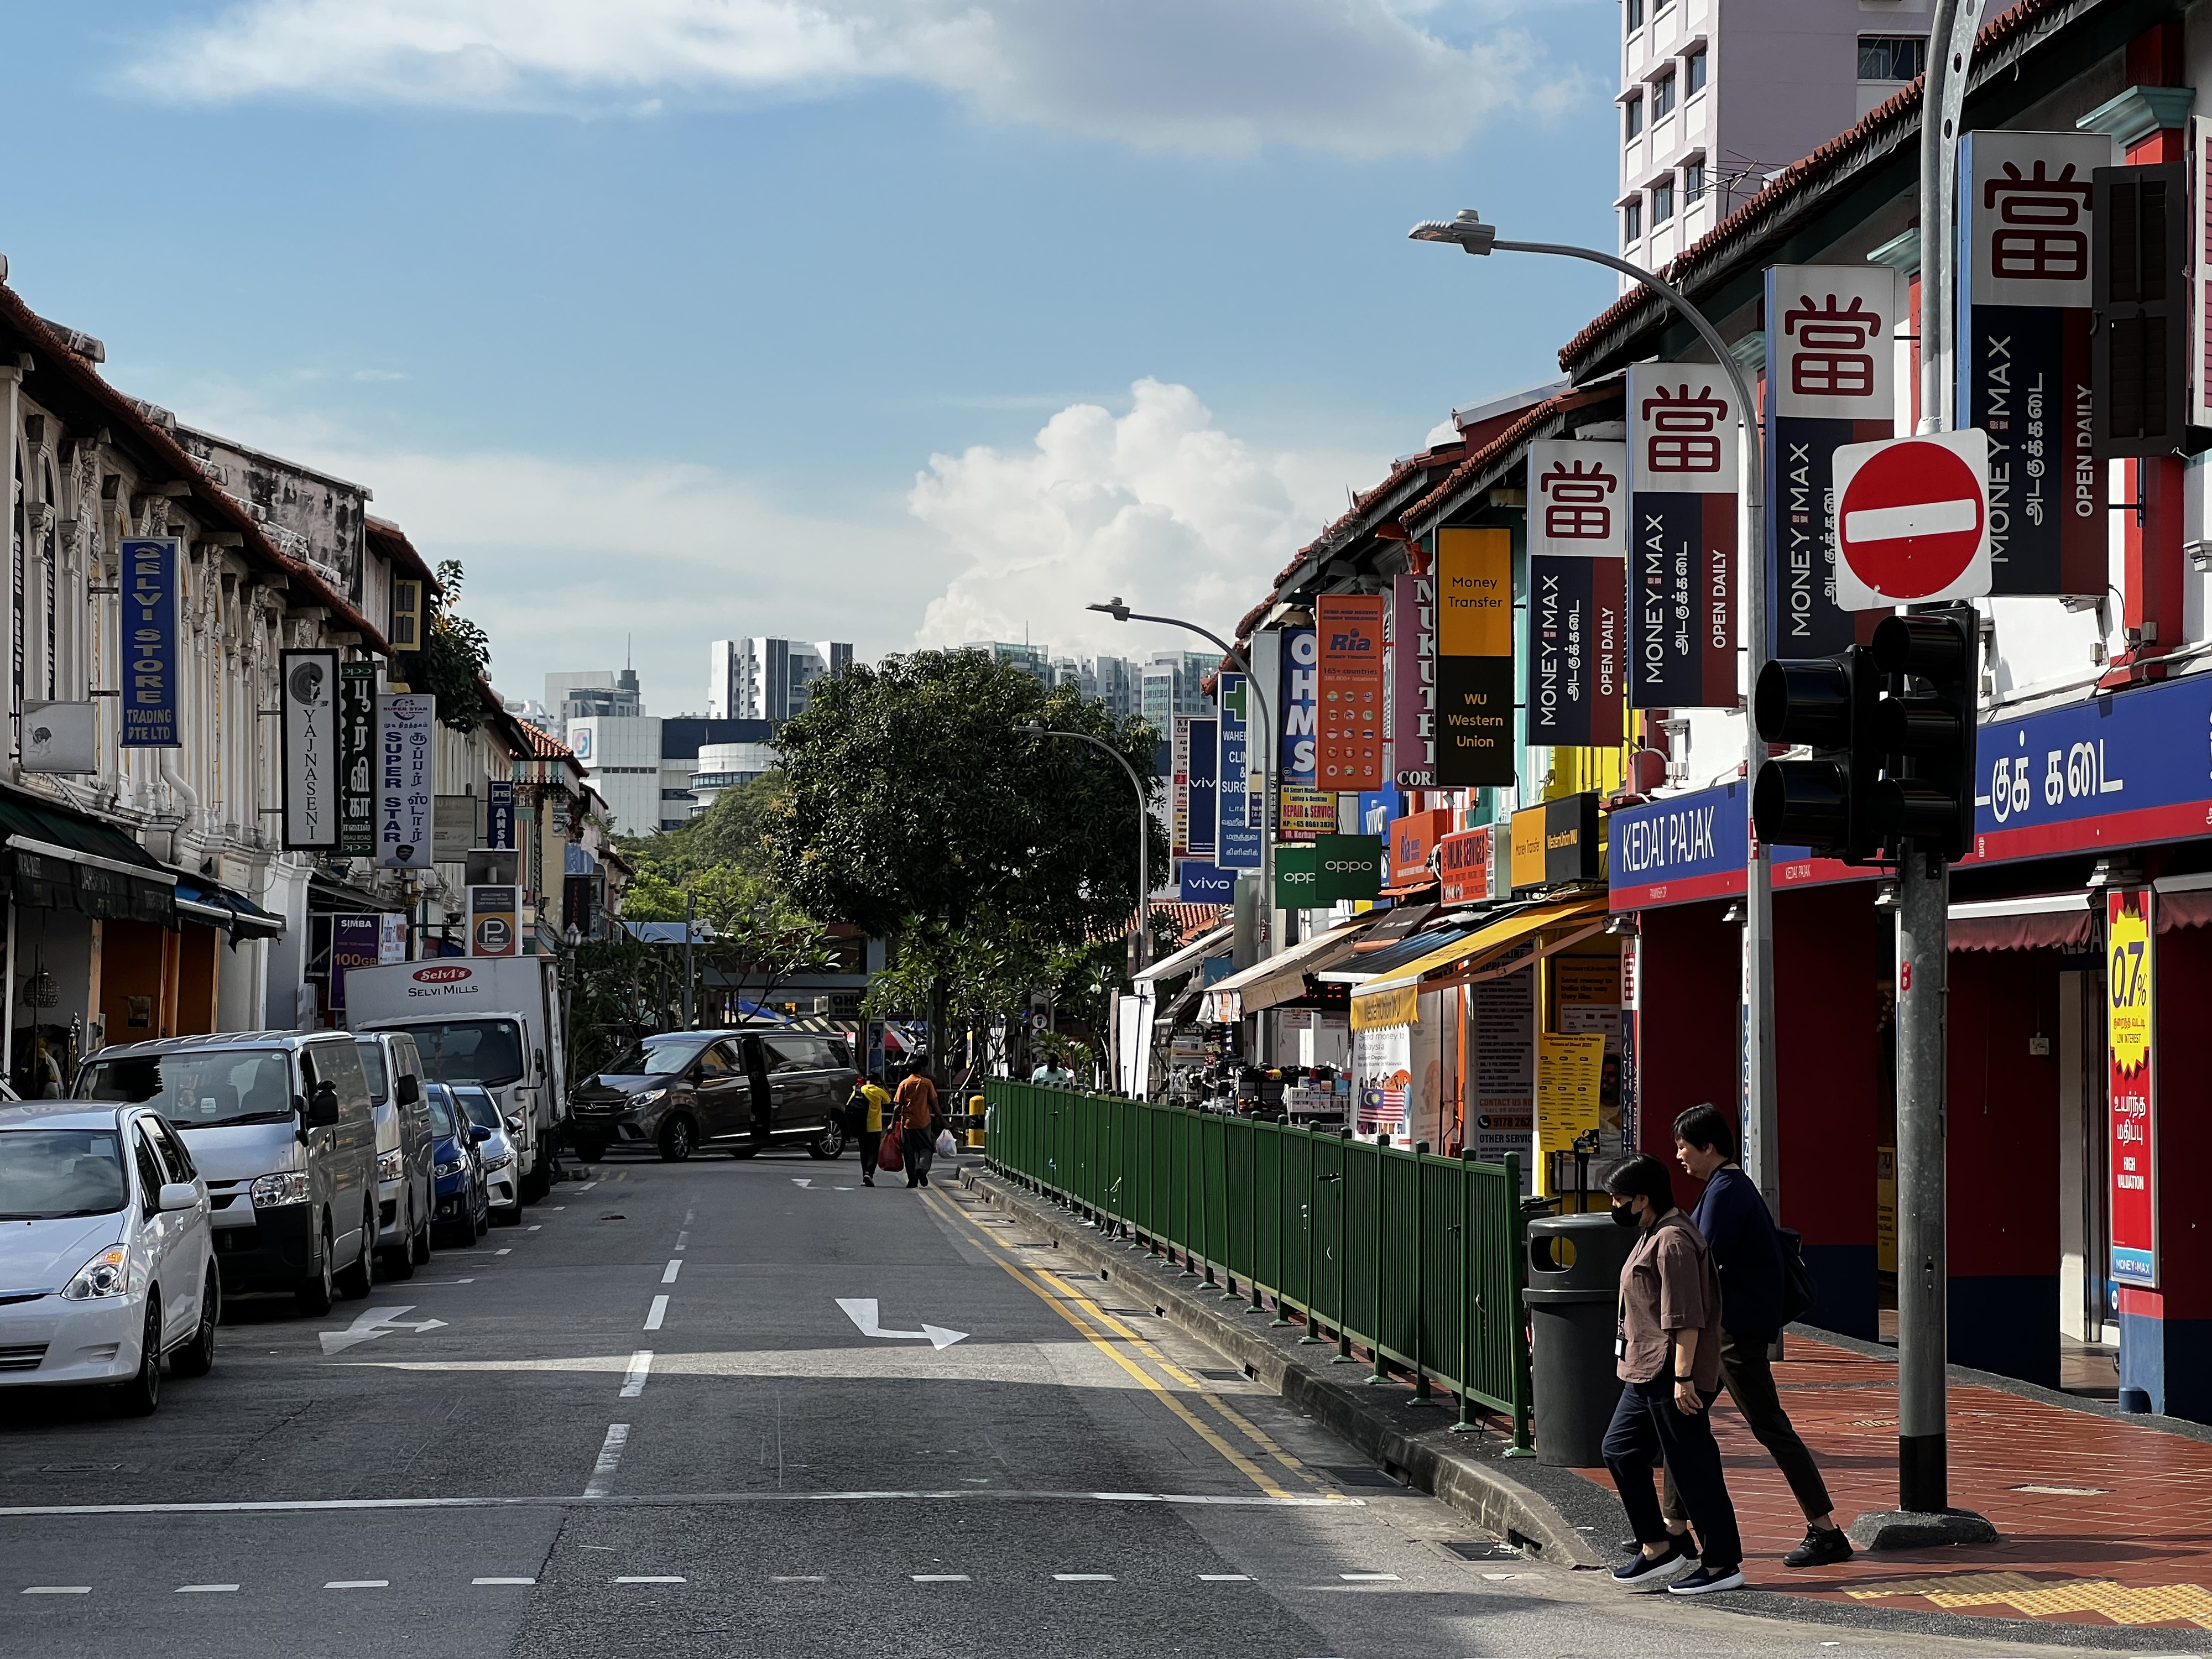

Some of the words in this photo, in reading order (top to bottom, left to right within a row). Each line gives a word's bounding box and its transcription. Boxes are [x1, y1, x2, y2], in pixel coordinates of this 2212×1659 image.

[1987, 335, 2012, 416] MAX
[2075, 383, 2093, 447] DAILY
[1790, 442, 1809, 512] MAX
[2075, 453, 2094, 518] OPEN
[1990, 438, 2010, 563] MONEY
[1645, 514, 1663, 575] MAX
[1712, 549, 1726, 598] DAILY
[1452, 576, 1498, 590] Money
[1790, 528, 1811, 637] MONEY
[1448, 596, 1503, 608] Transfer
[1542, 575, 1558, 628] MAX
[1601, 607, 1614, 649] DAILY
[1712, 602, 1726, 649] OPEN
[1330, 628, 1371, 651] Ria
[1645, 591, 1663, 683] MONEY
[133, 629, 164, 704] STORE
[1600, 654, 1614, 696] OPEN
[1541, 641, 1557, 726] MONEY
[1286, 633, 1317, 773] OHMS
[1464, 693, 1488, 705] WU
[126, 708, 171, 724] TRADING
[1448, 714, 1503, 727] Western
[128, 726, 148, 740] PTE
[150, 726, 170, 740] LTD
[1457, 735, 1494, 748] Union
[384, 731, 402, 789] SUPER
[303, 709, 318, 839] YAJNASENI
[1239, 766, 1246, 779] &
[1397, 770, 1435, 786] COR
[2045, 738, 2124, 806] கடை
[1190, 777, 1216, 788] viv
[1222, 781, 1246, 794] SURG
[1283, 805, 1303, 817] REPAIR
[1305, 807, 1309, 818] &
[1310, 805, 1334, 818] SERVICE
[383, 797, 402, 843] STAR
[1623, 816, 1665, 873] KEDAI
[1670, 805, 1714, 864] PAJAK
[1325, 860, 1373, 873] oppo
[1188, 877, 1230, 890] vivo
[1284, 872, 1316, 885] opp
[341, 920, 372, 928] SIMBA
[484, 920, 504, 943] P
[334, 953, 377, 966] 100GB
[420, 968, 466, 982] Selvi's
[408, 987, 440, 997] SELVI
[444, 985, 479, 994] MILLS
[1359, 1032, 1374, 1041] Send
[1358, 1042, 1385, 1052] Malaysia
[1479, 1098, 1510, 1107] CONTACT
[1512, 1098, 1521, 1107] US
[1522, 1098, 1532, 1107] NO
[1493, 1117, 1513, 1127] 9178
[1514, 1117, 1532, 1127] 262
[1479, 1134, 1504, 1143] OTHER
[1505, 1134, 1532, 1143] SERVIC
[2123, 1156, 2136, 1171] HIGH
[2117, 1173, 2145, 1190] VALUATION
[2116, 1259, 2135, 1271] MONEY
[2136, 1260, 2151, 1275] MAX
